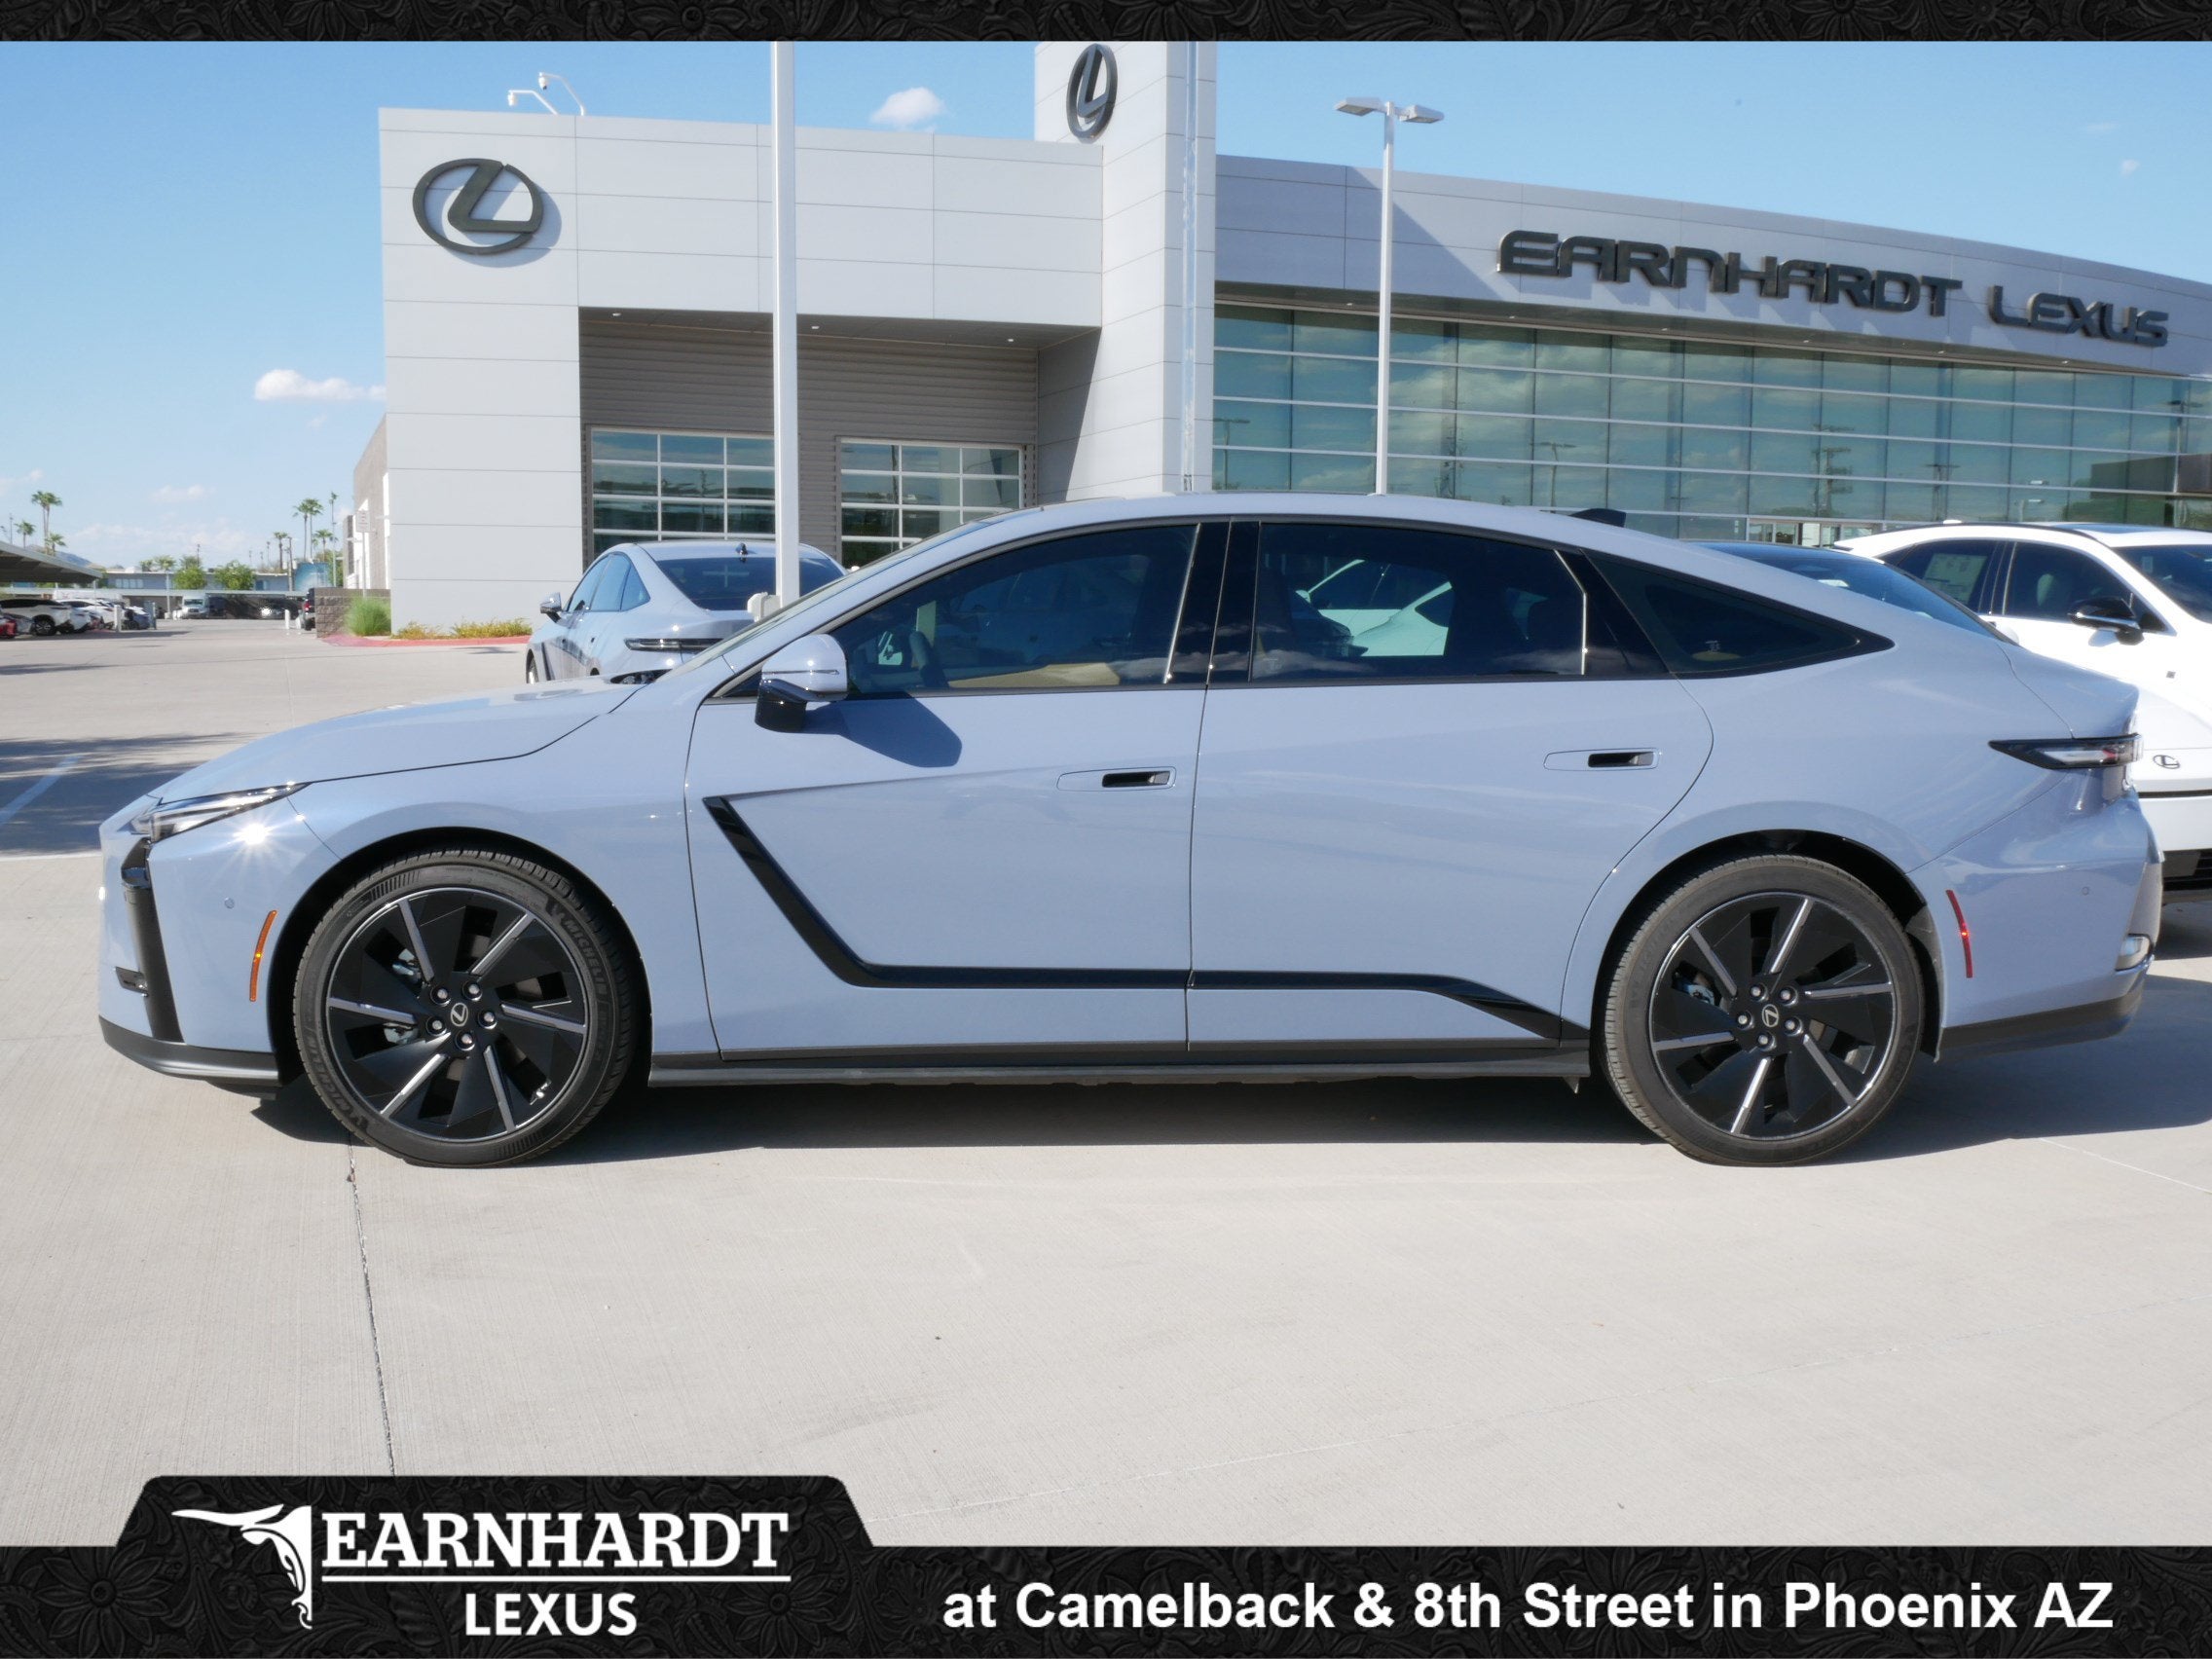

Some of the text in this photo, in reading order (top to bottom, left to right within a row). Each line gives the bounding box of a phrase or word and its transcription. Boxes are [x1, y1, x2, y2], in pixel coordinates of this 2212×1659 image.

[1498, 230, 2169, 348] EARNHARDT LEXUS
[564, 920, 609, 996] MICHELIN
